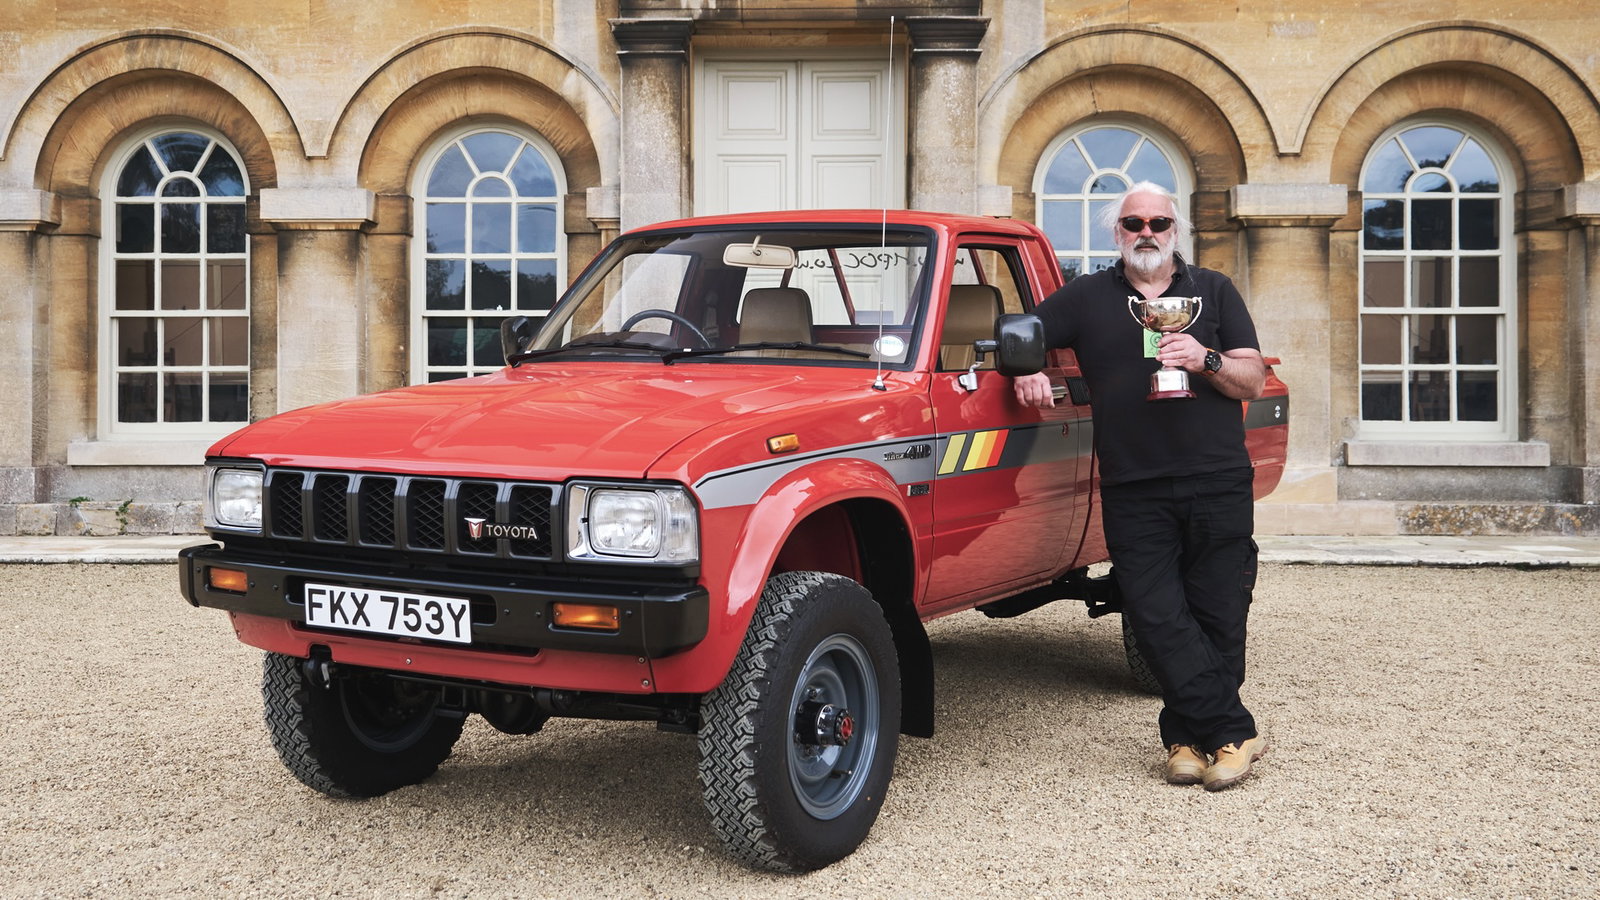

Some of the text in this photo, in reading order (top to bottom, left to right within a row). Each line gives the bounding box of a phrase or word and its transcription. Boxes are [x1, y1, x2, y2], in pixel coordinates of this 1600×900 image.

[485, 524, 538, 540] TOYOTA
[307, 588, 467, 638] FKX 753Y
